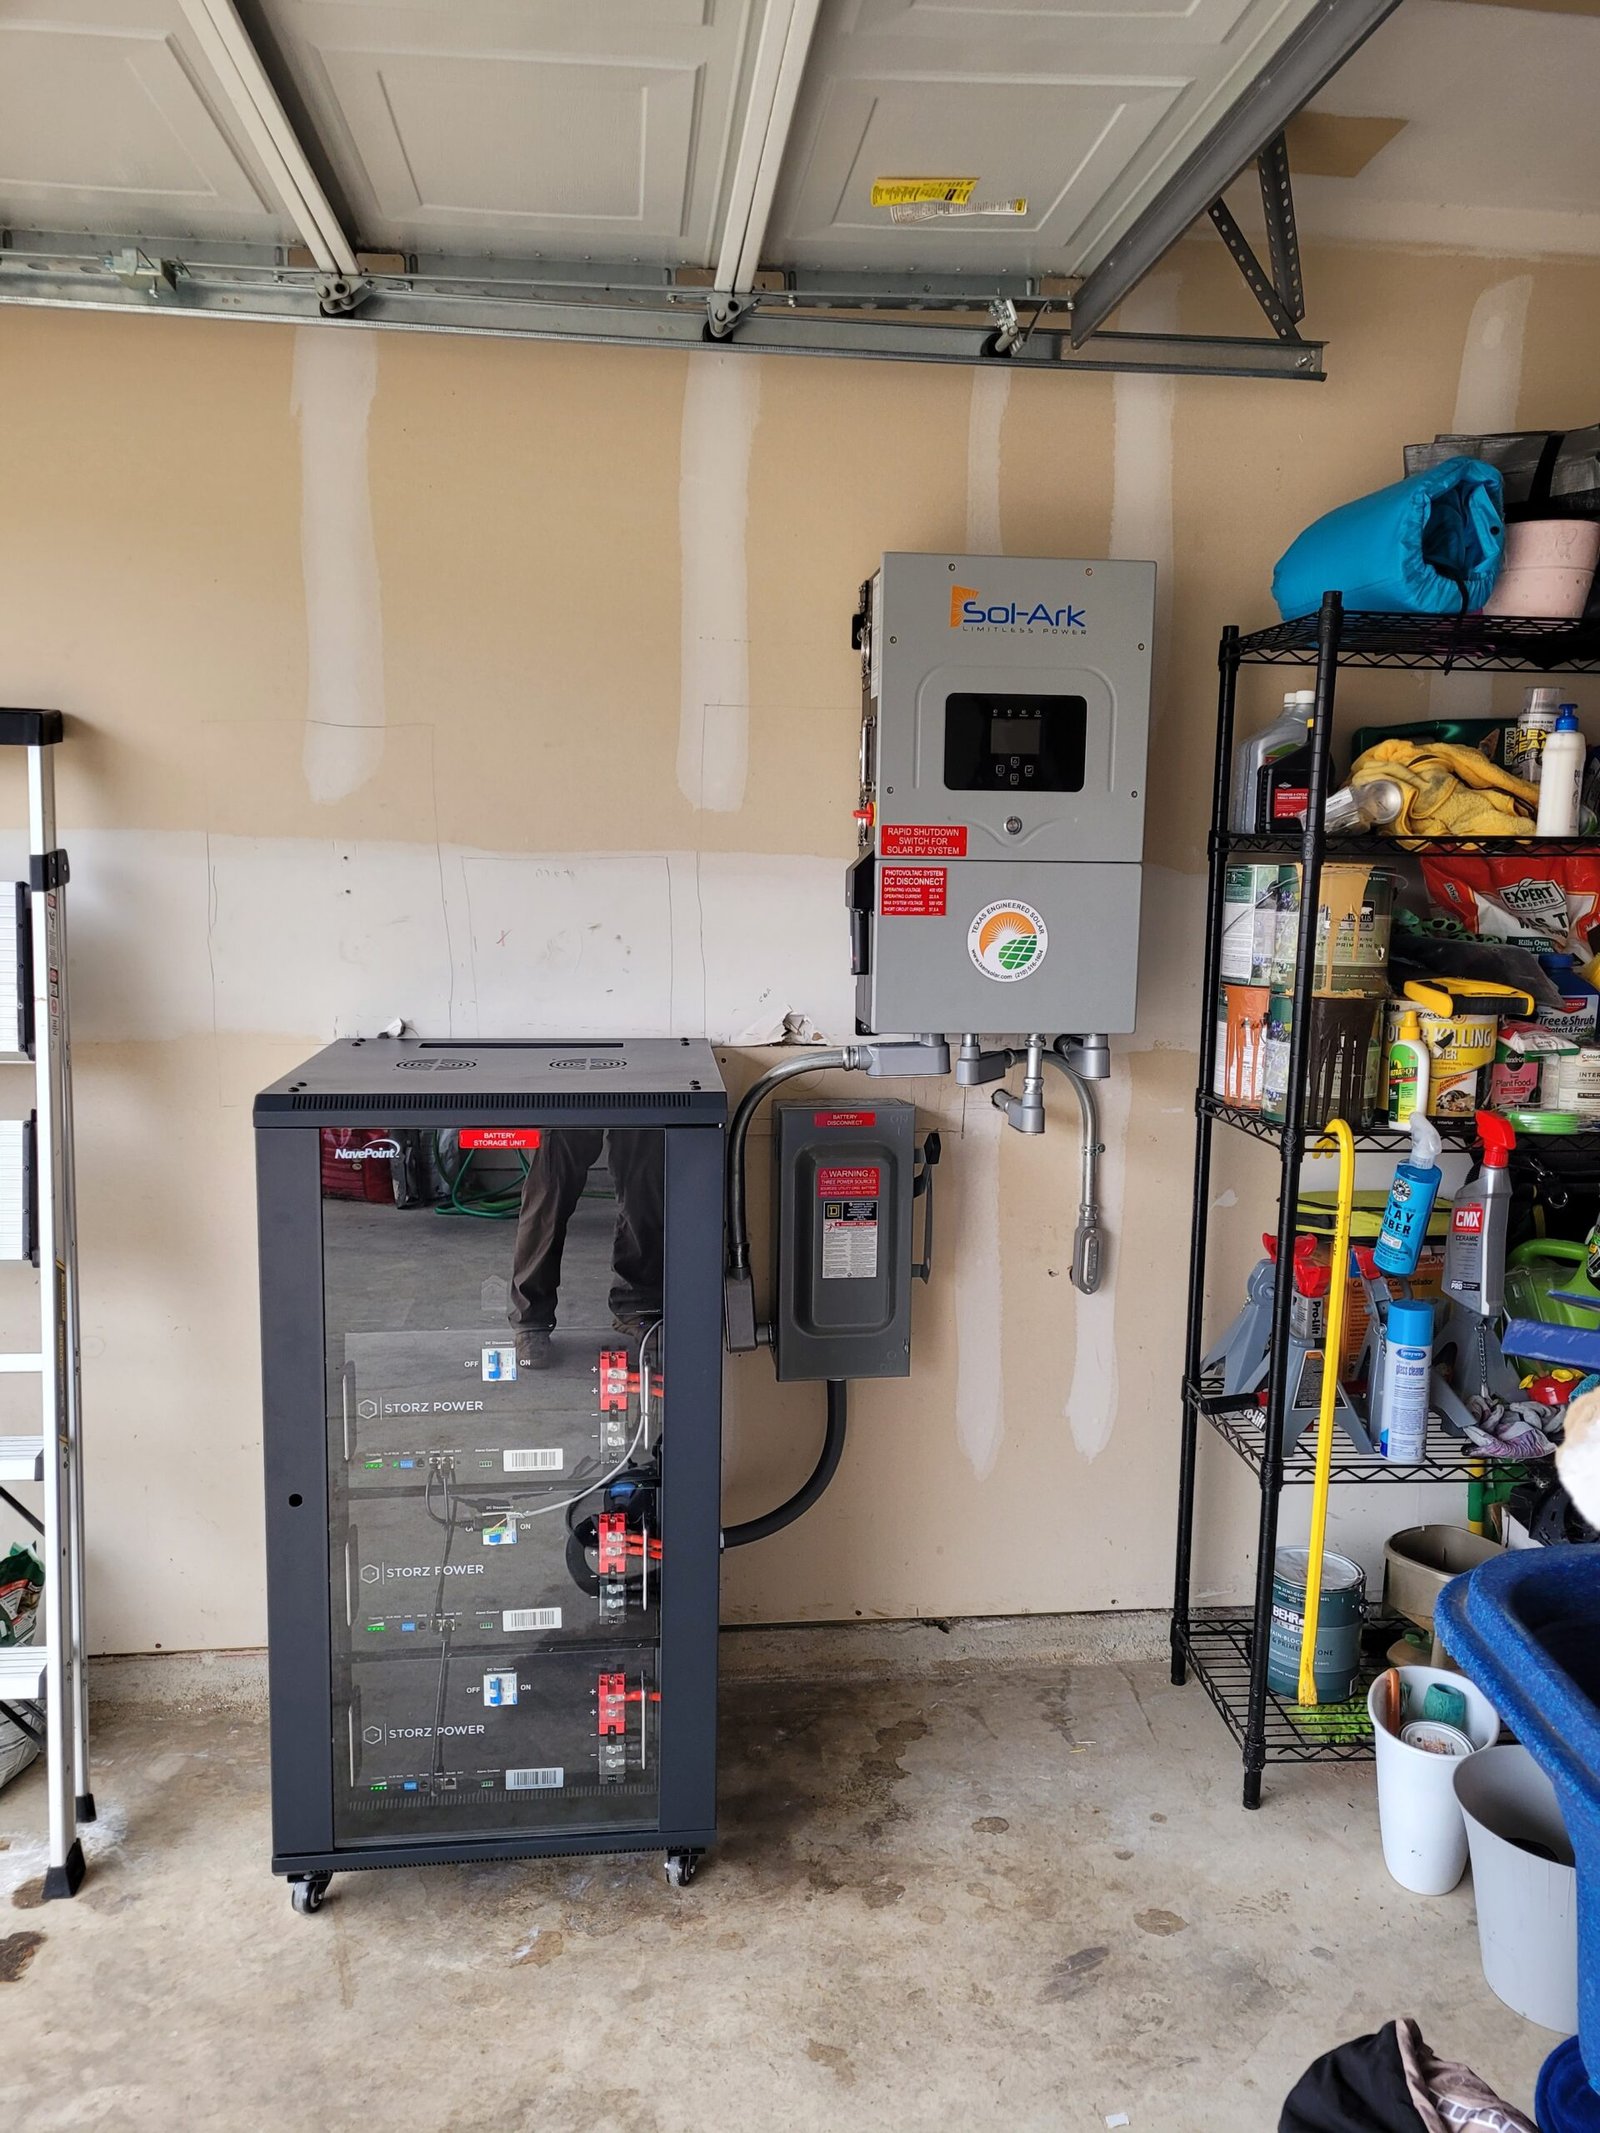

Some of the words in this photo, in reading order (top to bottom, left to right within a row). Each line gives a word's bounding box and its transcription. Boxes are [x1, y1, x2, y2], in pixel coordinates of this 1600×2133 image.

[962, 601, 1086, 628] Sol-Ark
[962, 626, 1034, 634] LIMITLESS
[1042, 628, 1087, 636] POWER
[887, 827, 912, 836] RAPID
[913, 827, 960, 837] SHUTDOWN
[898, 837, 930, 845] SWITCH
[931, 837, 948, 846] FOR
[886, 845, 913, 854] SOLAR
[914, 846, 926, 854] PV
[927, 846, 960, 855] SYSTEM
[923, 869, 944, 877] SYSTEM
[883, 877, 895, 886] DC
[896, 877, 945, 886] DISCONNECT
[1503, 886, 1556, 904] EXPERT
[971, 912, 987, 934] TEXAS
[986, 901, 1031, 915] ENGINEERED
[1029, 912, 1045, 935] SOLAR
[1014, 968, 1029, 979] (210)
[1539, 1015, 1561, 1026] Tree
[1561, 1015, 1568, 1025] &
[1568, 1014, 1596, 1025] Shrub
[1496, 1079, 1514, 1087] Plant
[1514, 1079, 1531, 1087] Food
[509, 1139, 527, 1147] UNIT
[334, 1147, 394, 1160] NavePoint
[828, 1169, 869, 1178] WARNING
[1387, 1204, 1415, 1223] LAY
[1455, 1211, 1481, 1228] CMX
[1383, 1217, 1412, 1235] UBER
[1450, 1281, 1463, 1290] PRO
[1311, 1300, 1321, 1335] Pro-Lift
[464, 1360, 479, 1368] OFF
[1395, 1364, 1408, 1377] glass
[1408, 1364, 1425, 1376] cleaner
[384, 1402, 430, 1413] STORZ
[433, 1400, 484, 1412] POWER
[1243, 1408, 1266, 1430] ro-Lift
[386, 1566, 431, 1578] STORZ
[1272, 1604, 1299, 1625] BEHR
[1277, 1639, 1302, 1652] PRIME
[466, 1686, 481, 1694] OFF
[388, 1727, 432, 1739] STORZ
[436, 1724, 485, 1736] POWER
